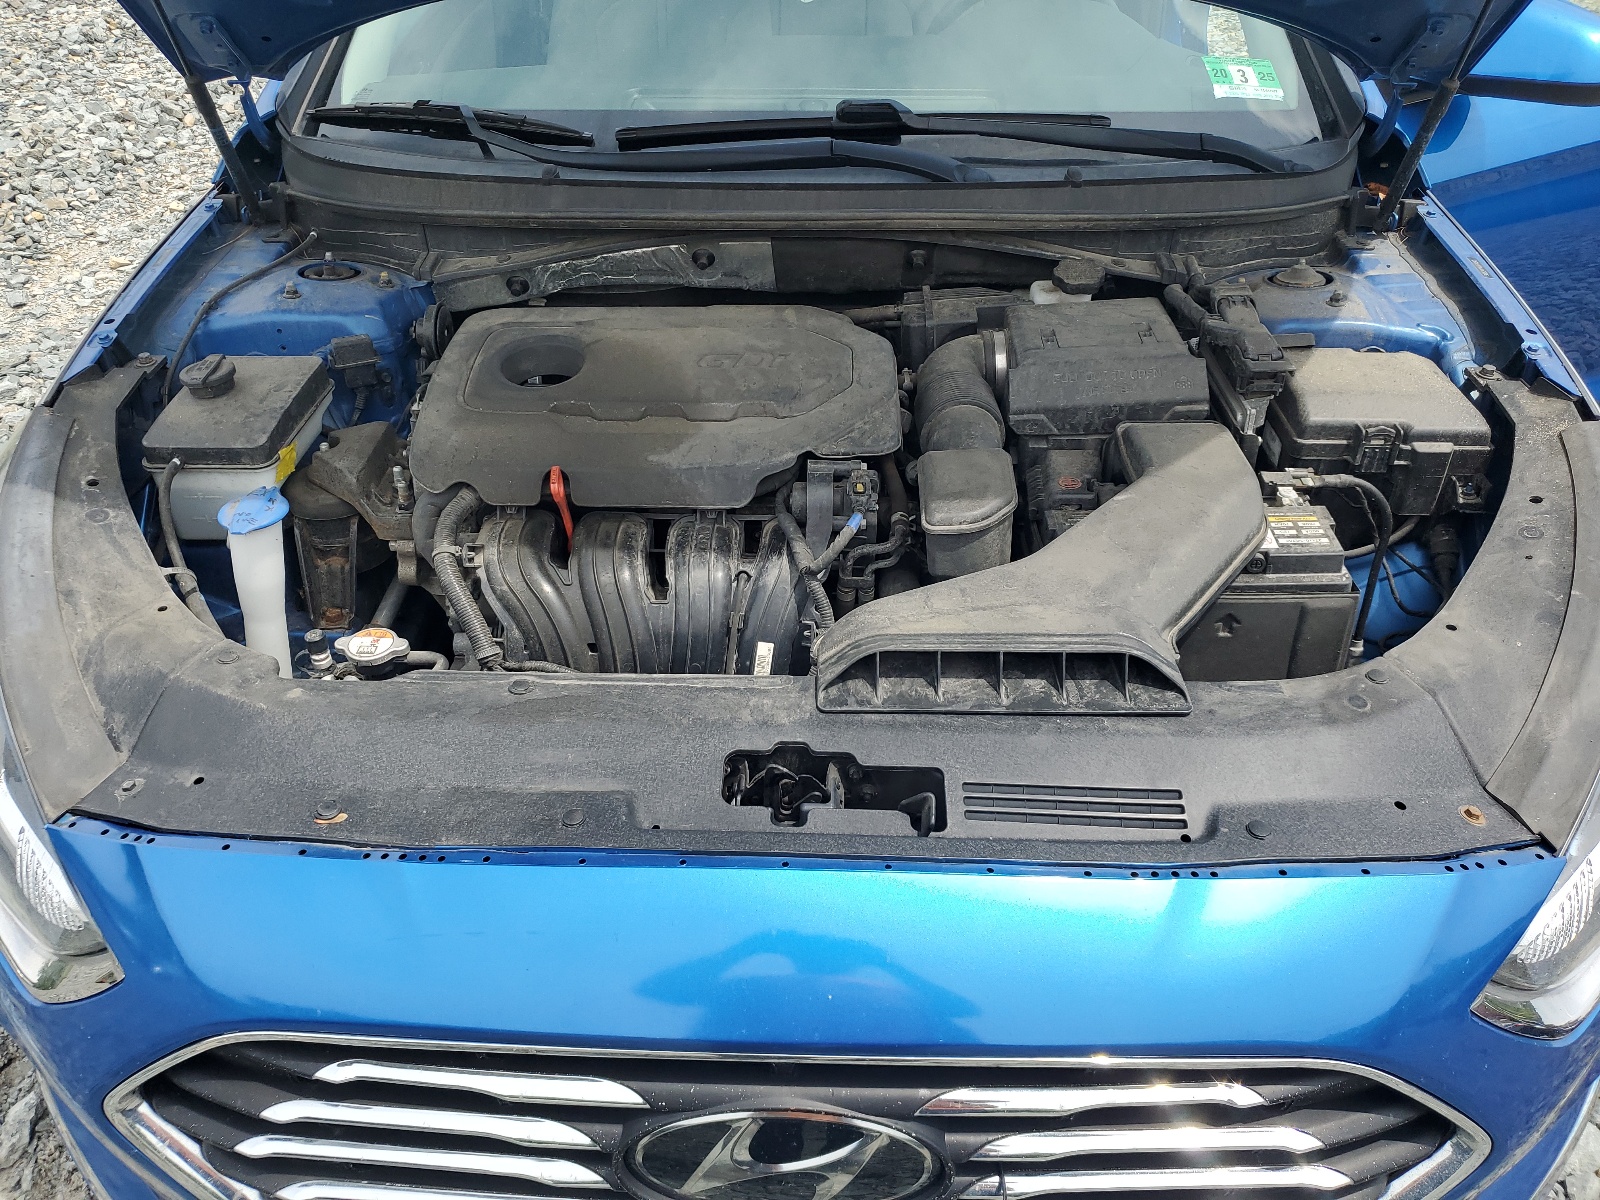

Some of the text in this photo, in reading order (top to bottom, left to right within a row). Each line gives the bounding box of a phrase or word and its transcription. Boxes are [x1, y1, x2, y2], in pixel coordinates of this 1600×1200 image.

[1212, 68, 1276, 84] 20 3 25
